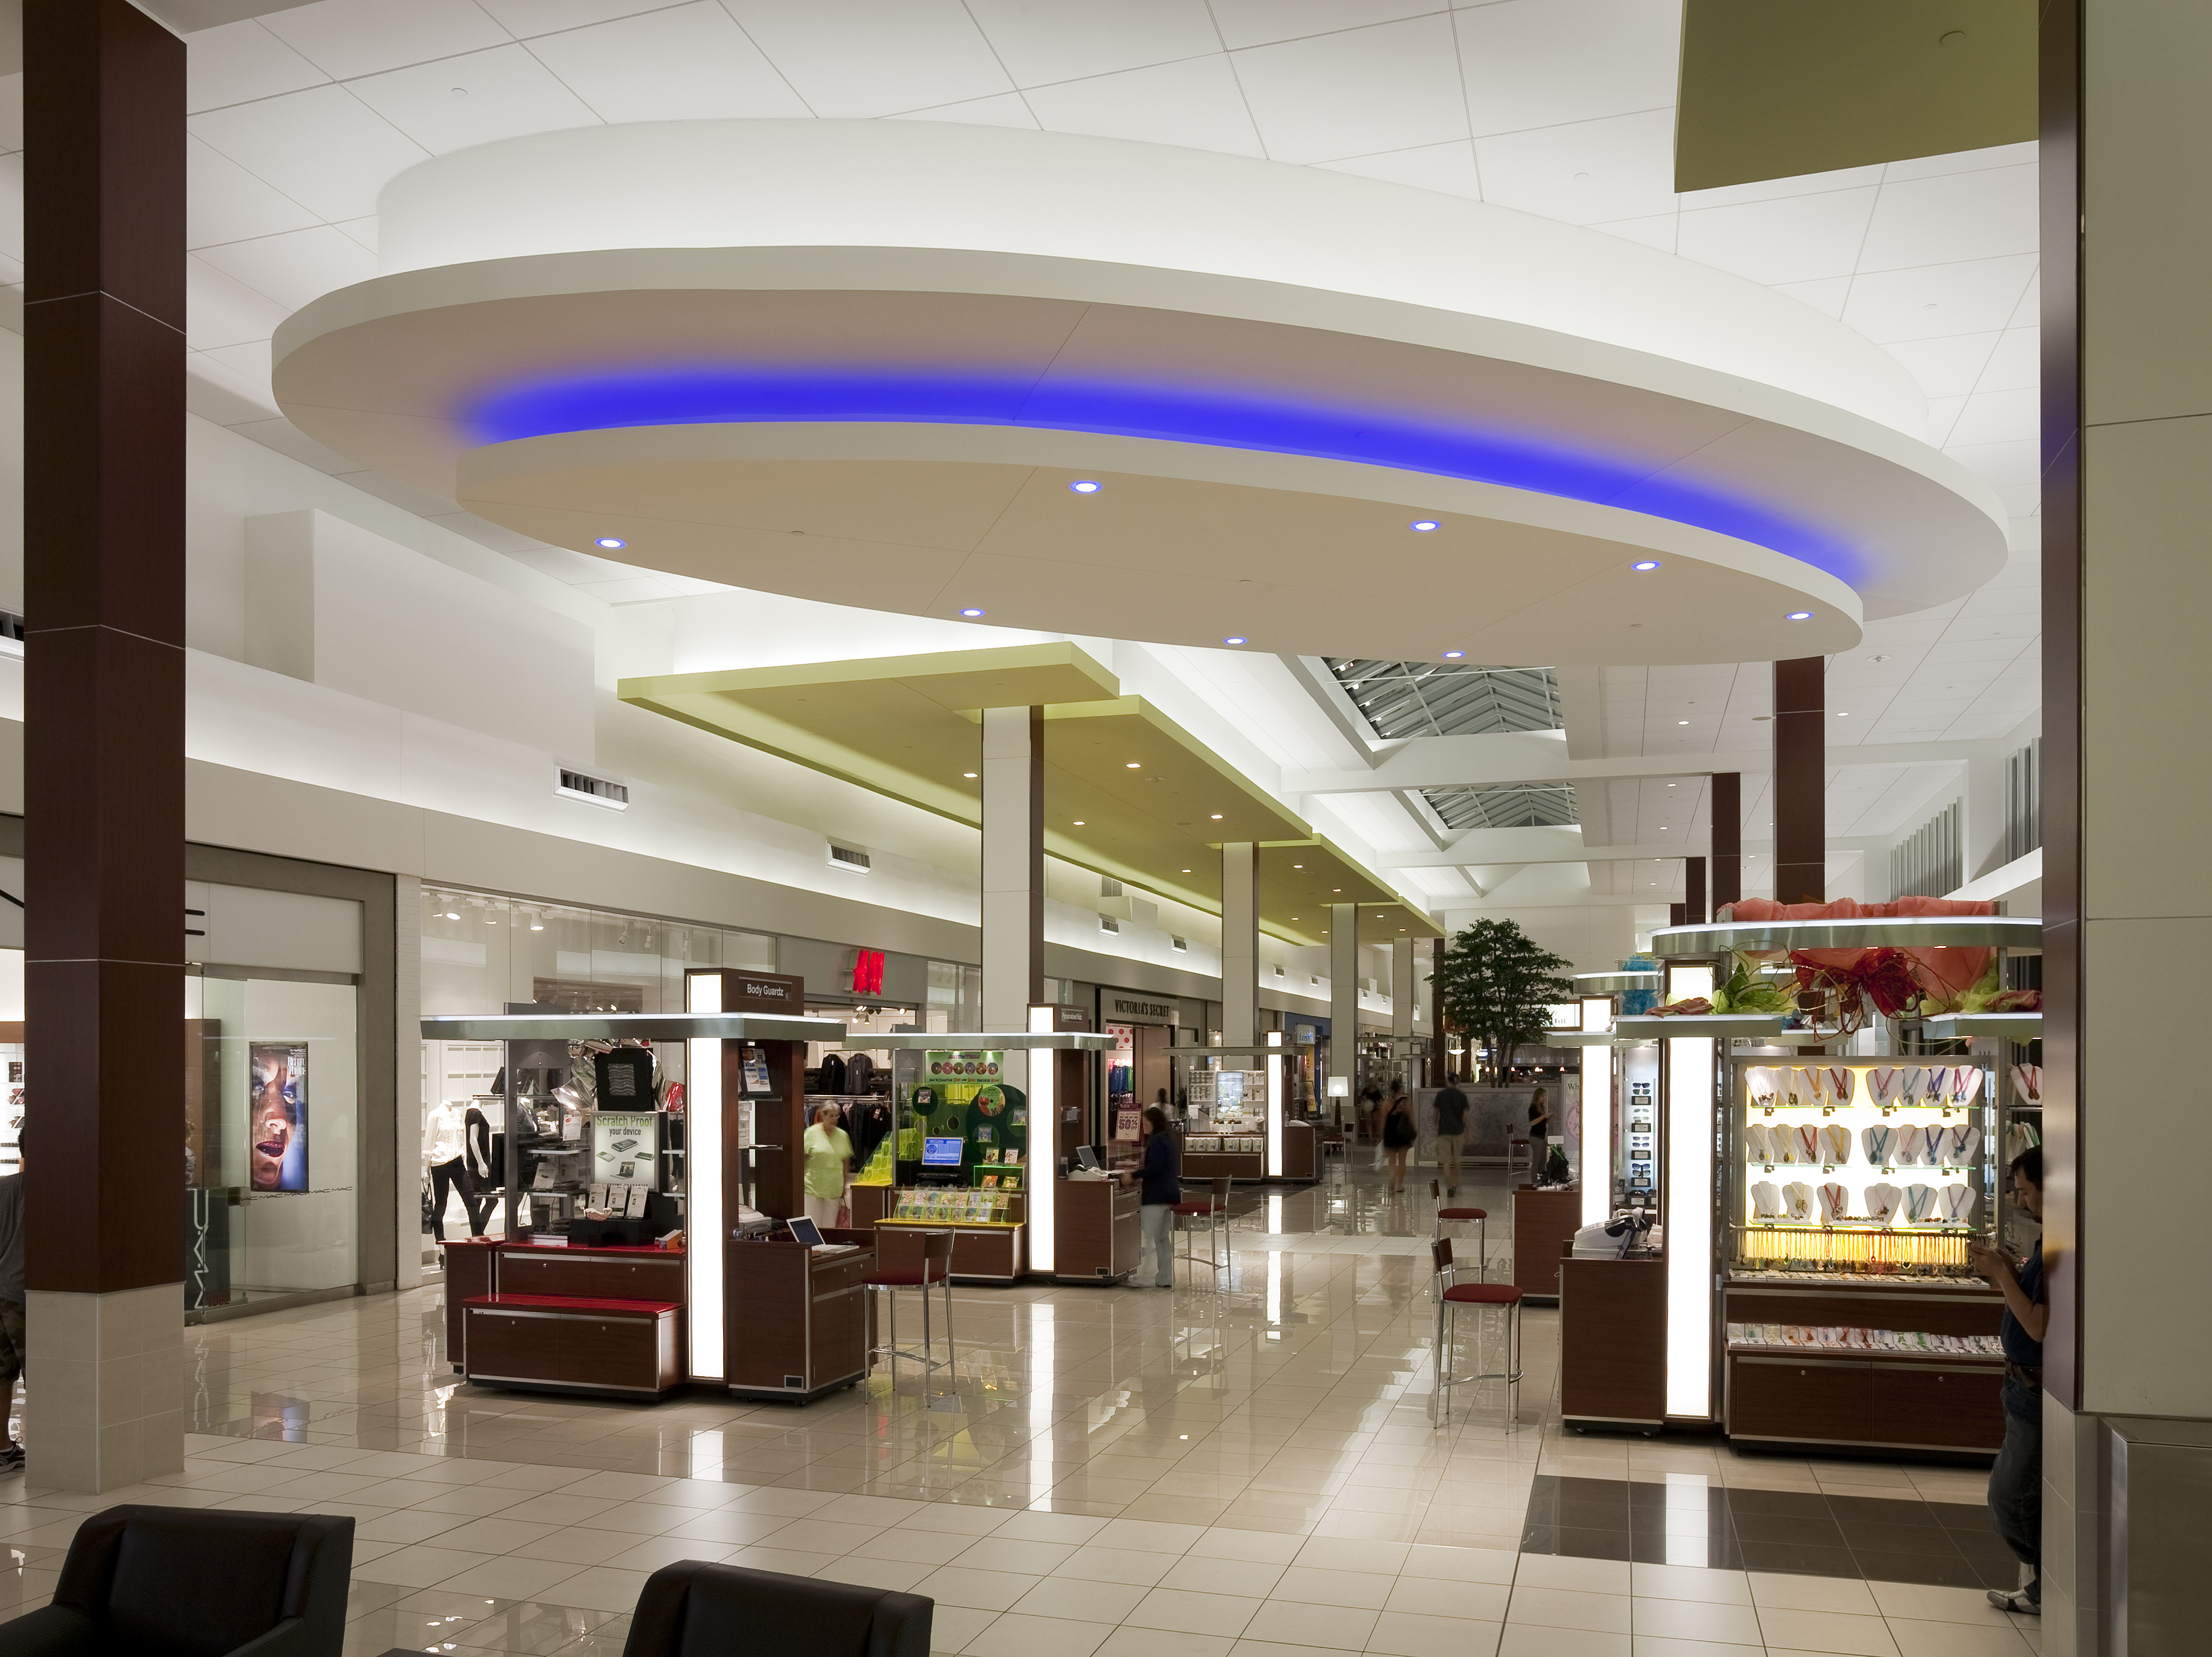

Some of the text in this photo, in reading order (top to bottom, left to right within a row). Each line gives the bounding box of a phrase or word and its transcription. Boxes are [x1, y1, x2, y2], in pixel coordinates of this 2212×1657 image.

[747, 983, 762, 997] Body
[763, 985, 783, 996] Guardz
[1114, 999, 1170, 1018] VICTORIA'S SECRET
[596, 1116, 653, 1127] Scratch Proof
[1119, 1119, 1138, 1130] 50%
[609, 1127, 642, 1137] your device
[207, 1295, 230, 1307] 1062
